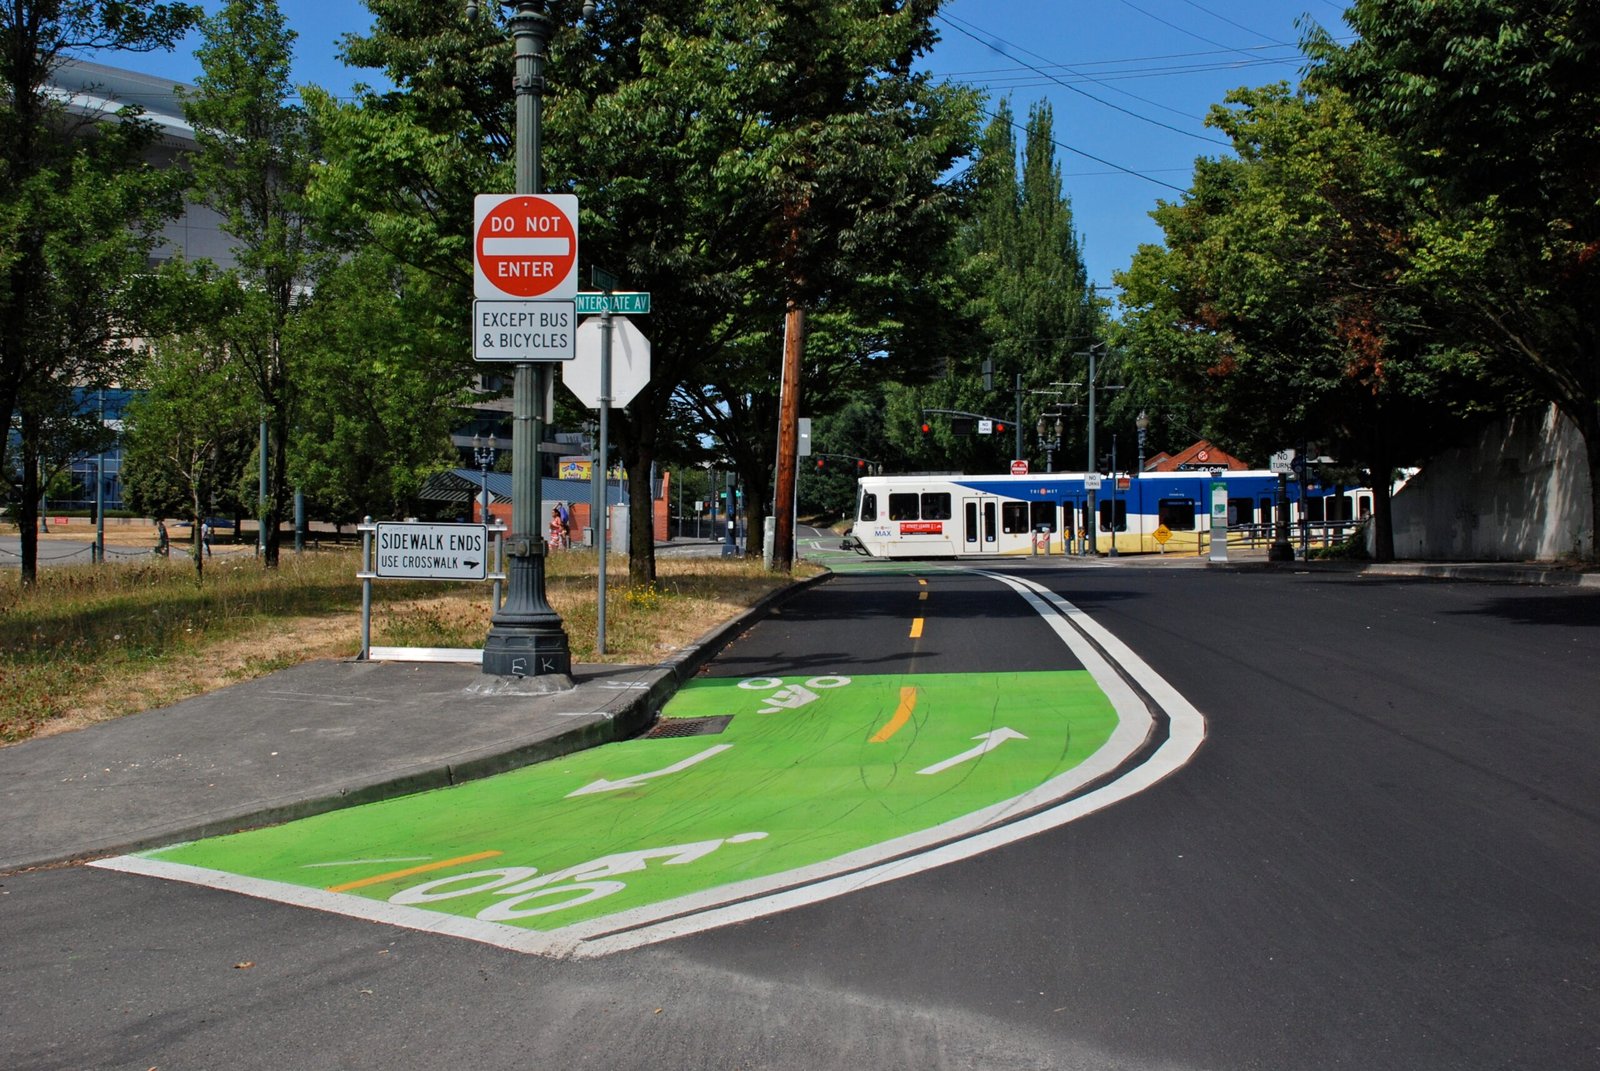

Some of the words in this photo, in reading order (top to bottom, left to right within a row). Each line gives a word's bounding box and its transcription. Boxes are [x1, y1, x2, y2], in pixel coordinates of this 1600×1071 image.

[491, 216, 515, 232] DO
[526, 216, 561, 232] NOT
[498, 261, 554, 277] ENTER
[634, 296, 647, 310] AV
[482, 312, 536, 328] EXCEPT
[540, 312, 568, 328] BUS
[482, 332, 495, 348] &
[500, 333, 568, 348] BICYCLES
[381, 532, 444, 551] SIDEWALK
[449, 534, 482, 552] ENDS
[381, 555, 399, 568] USE
[402, 555, 459, 569] CROSSWALK
